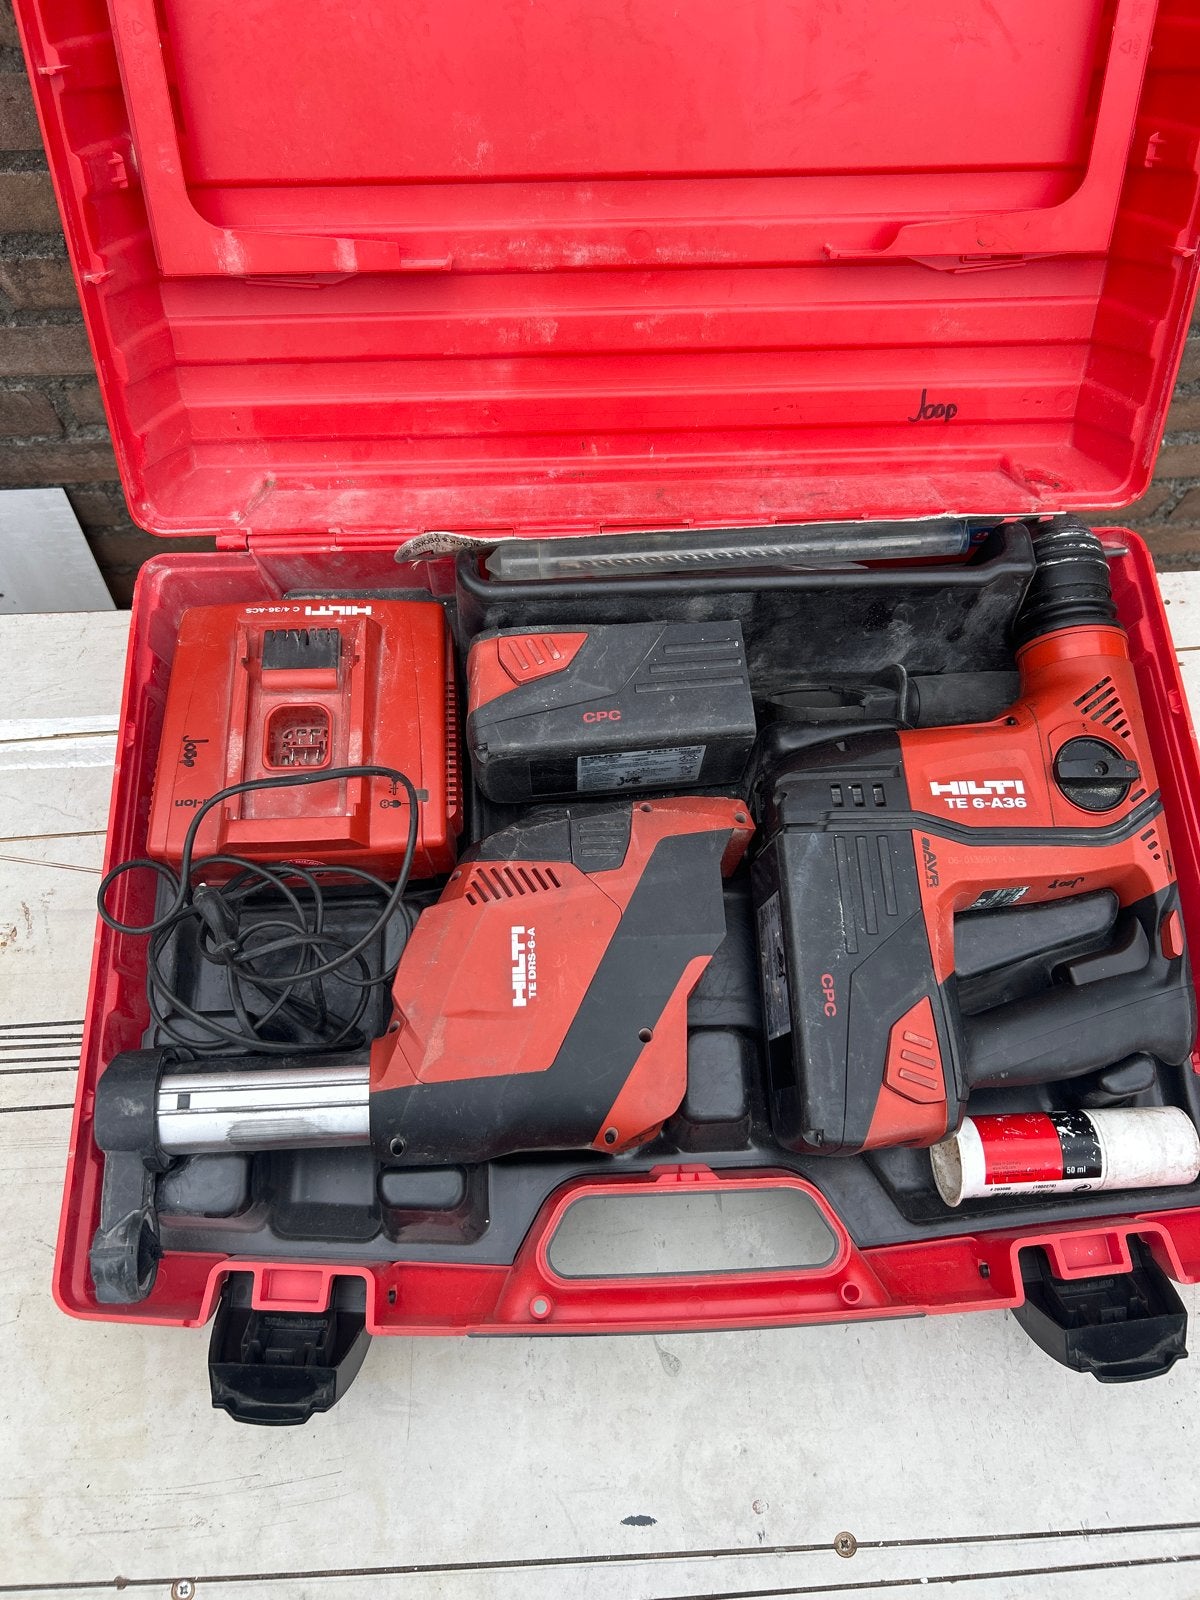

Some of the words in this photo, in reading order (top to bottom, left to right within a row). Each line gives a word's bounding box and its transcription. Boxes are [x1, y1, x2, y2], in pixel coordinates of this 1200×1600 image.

[908, 388, 958, 422] Joop
[245, 606, 290, 614] 4/36-ACS
[304, 605, 372, 616] HILTI
[583, 710, 621, 723] CPC
[178, 735, 209, 767] Joop
[929, 780, 1025, 796] HILTI
[944, 797, 968, 809] TE
[972, 797, 1027, 809] 6-A36
[923, 849, 940, 888] AVR
[527, 926, 537, 980] DRS-6-A
[511, 926, 527, 1007] HILTI
[528, 981, 537, 999] TE
[821, 973, 837, 1017] CPC
[1066, 1166, 1075, 1174] 50
[1077, 1165, 1086, 1173] ml
